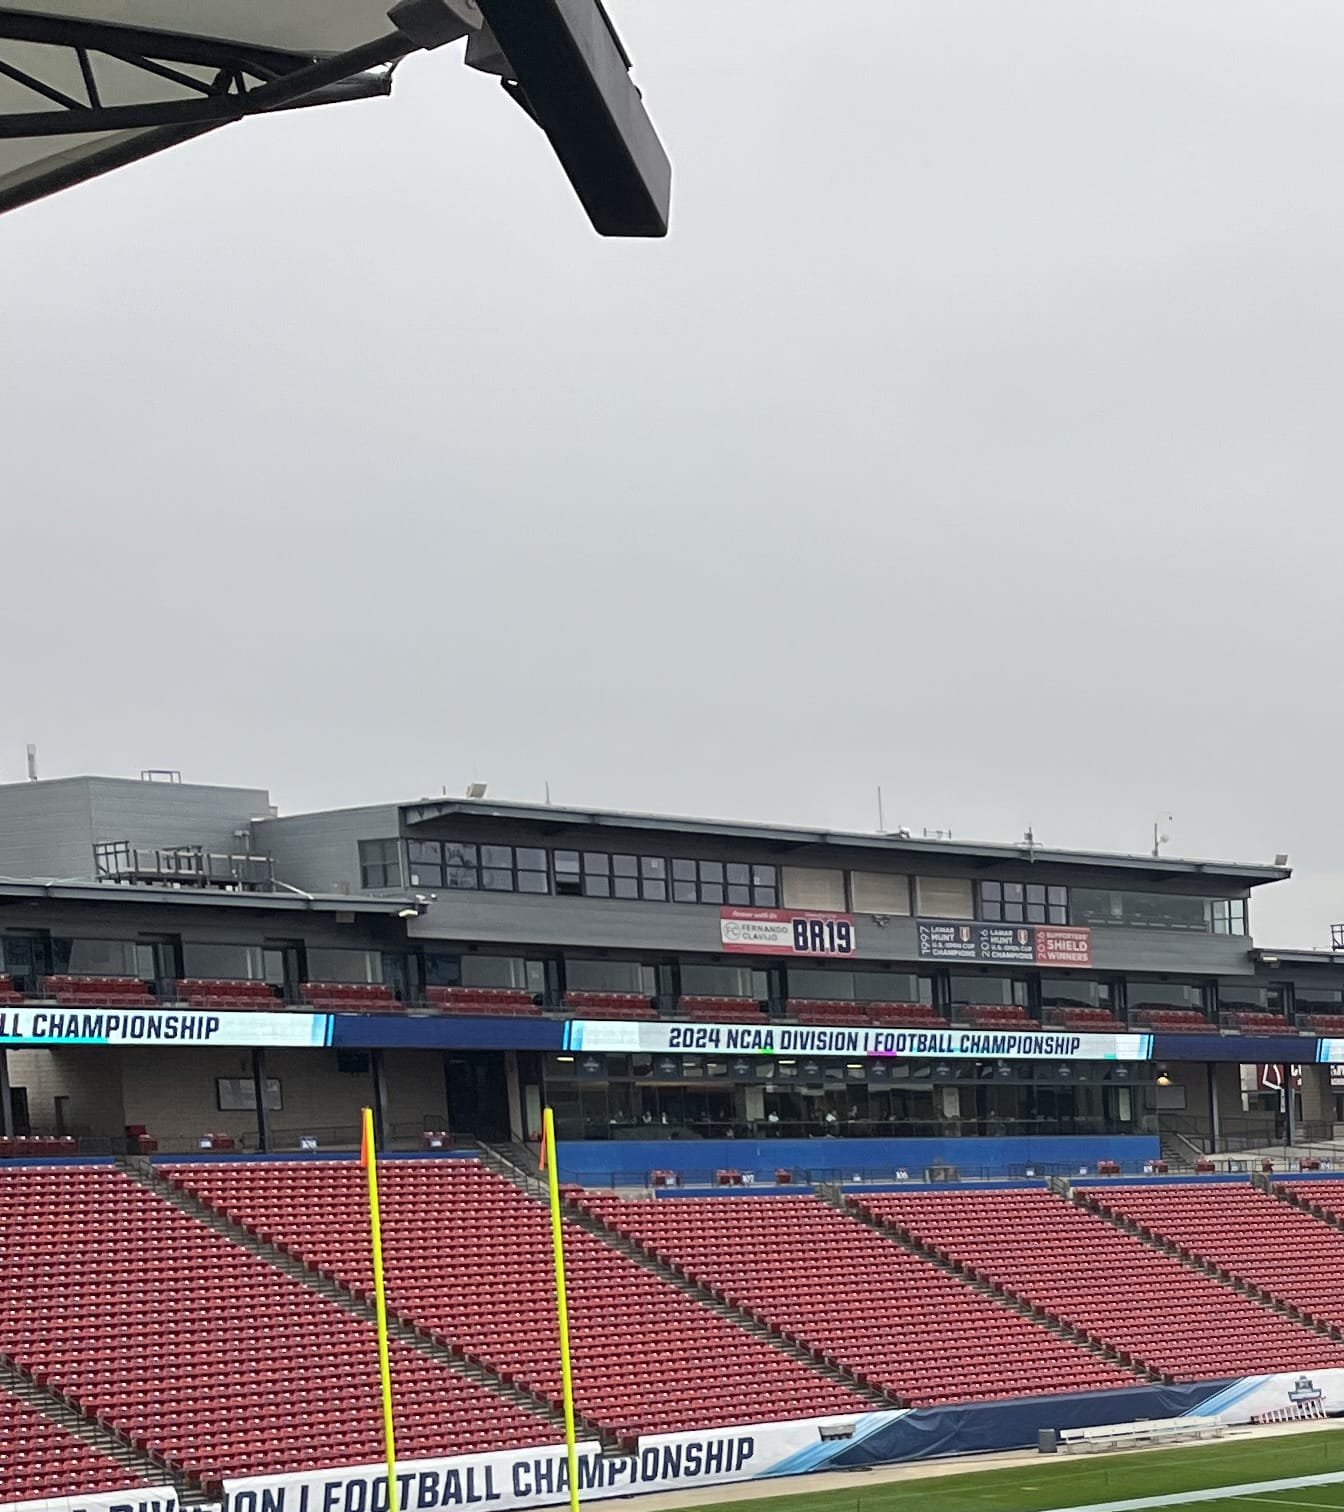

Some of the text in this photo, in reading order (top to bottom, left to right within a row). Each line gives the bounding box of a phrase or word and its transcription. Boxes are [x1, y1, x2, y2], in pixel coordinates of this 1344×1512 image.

[742, 923, 788, 934] FERNANDO
[792, 919, 852, 954] BR19
[1046, 940, 1088, 952] SHIELD
[1047, 951, 1089, 962] WINNERS
[32, 1013, 220, 1041] CHAMPIONSHIP
[668, 1027, 721, 1049] 2024
[726, 1028, 774, 1050] NCAA
[779, 1030, 858, 1052] DIVISION
[874, 1032, 955, 1054] FOOTBALL
[959, 1034, 1081, 1056] CHAMPIONSHIP
[512, 1437, 755, 1498] CHAMPIONSHIP
